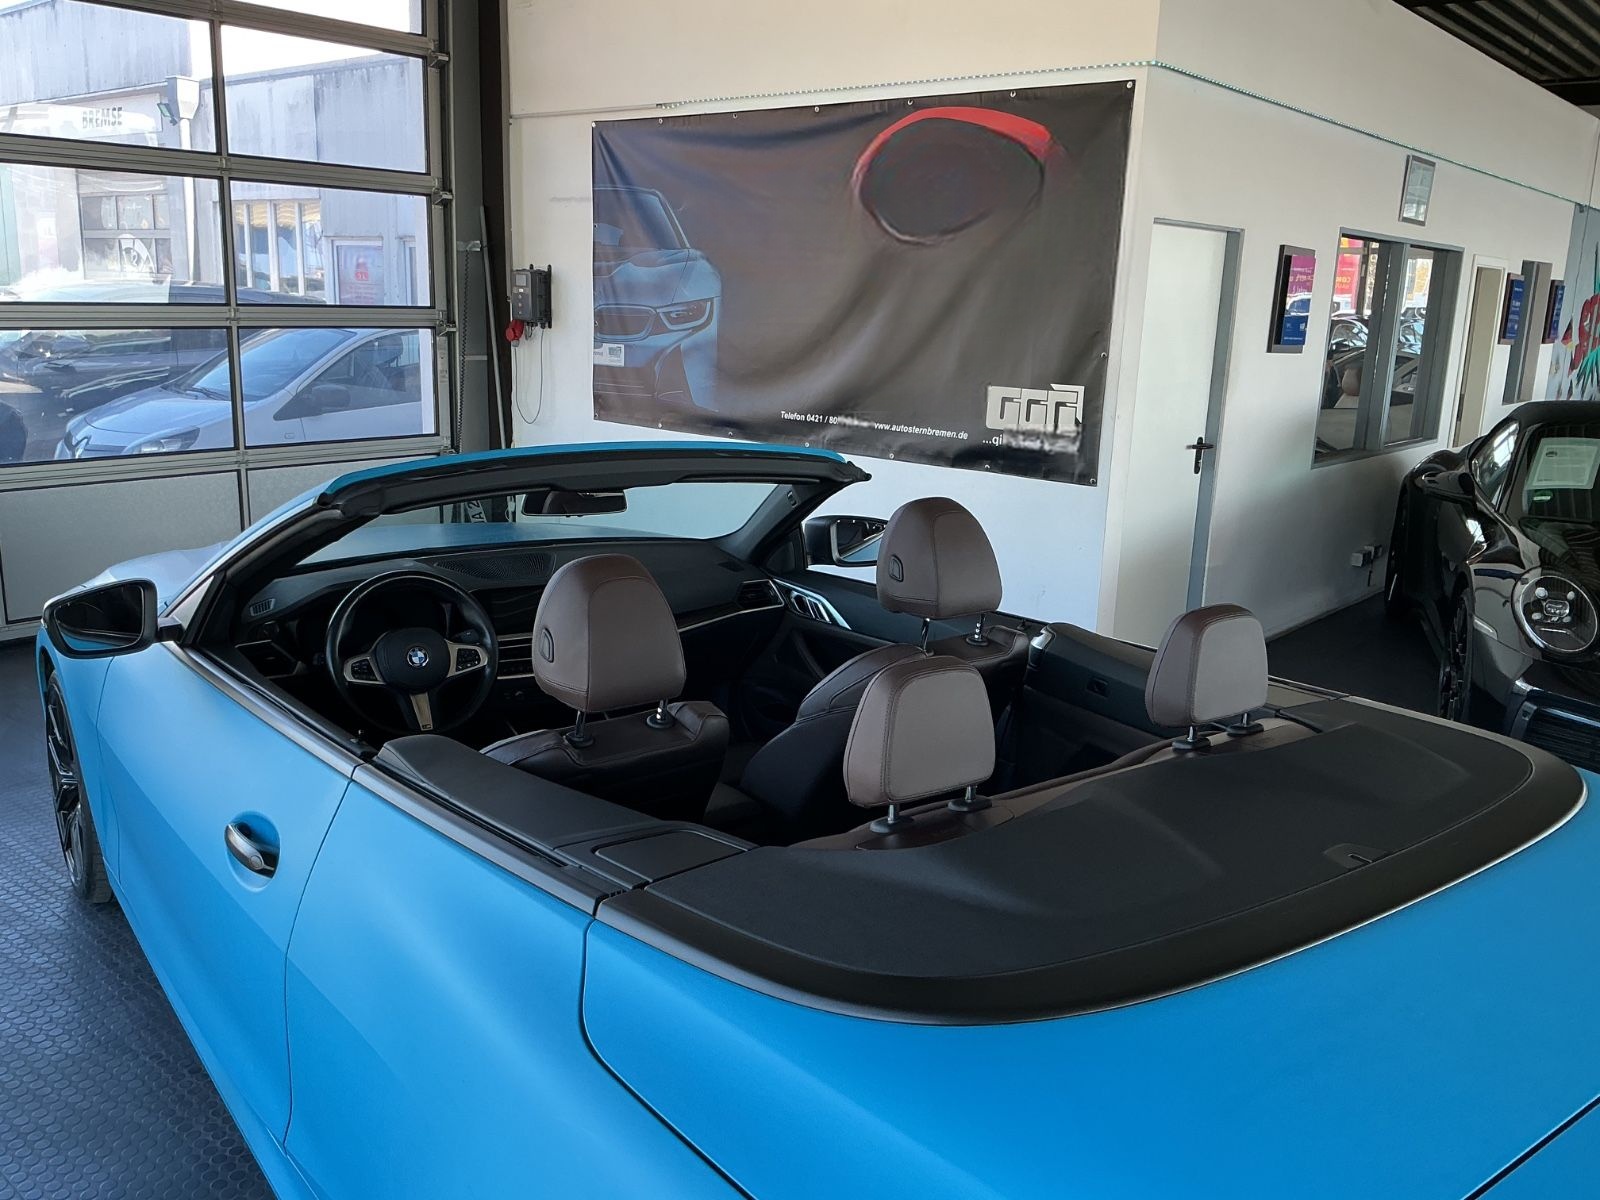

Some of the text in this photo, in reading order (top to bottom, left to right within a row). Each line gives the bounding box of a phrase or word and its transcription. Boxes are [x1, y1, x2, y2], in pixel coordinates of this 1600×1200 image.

[82, 106, 123, 128] BREMSE
[780, 411, 805, 421] Telefon
[806, 414, 823, 423] 0421
